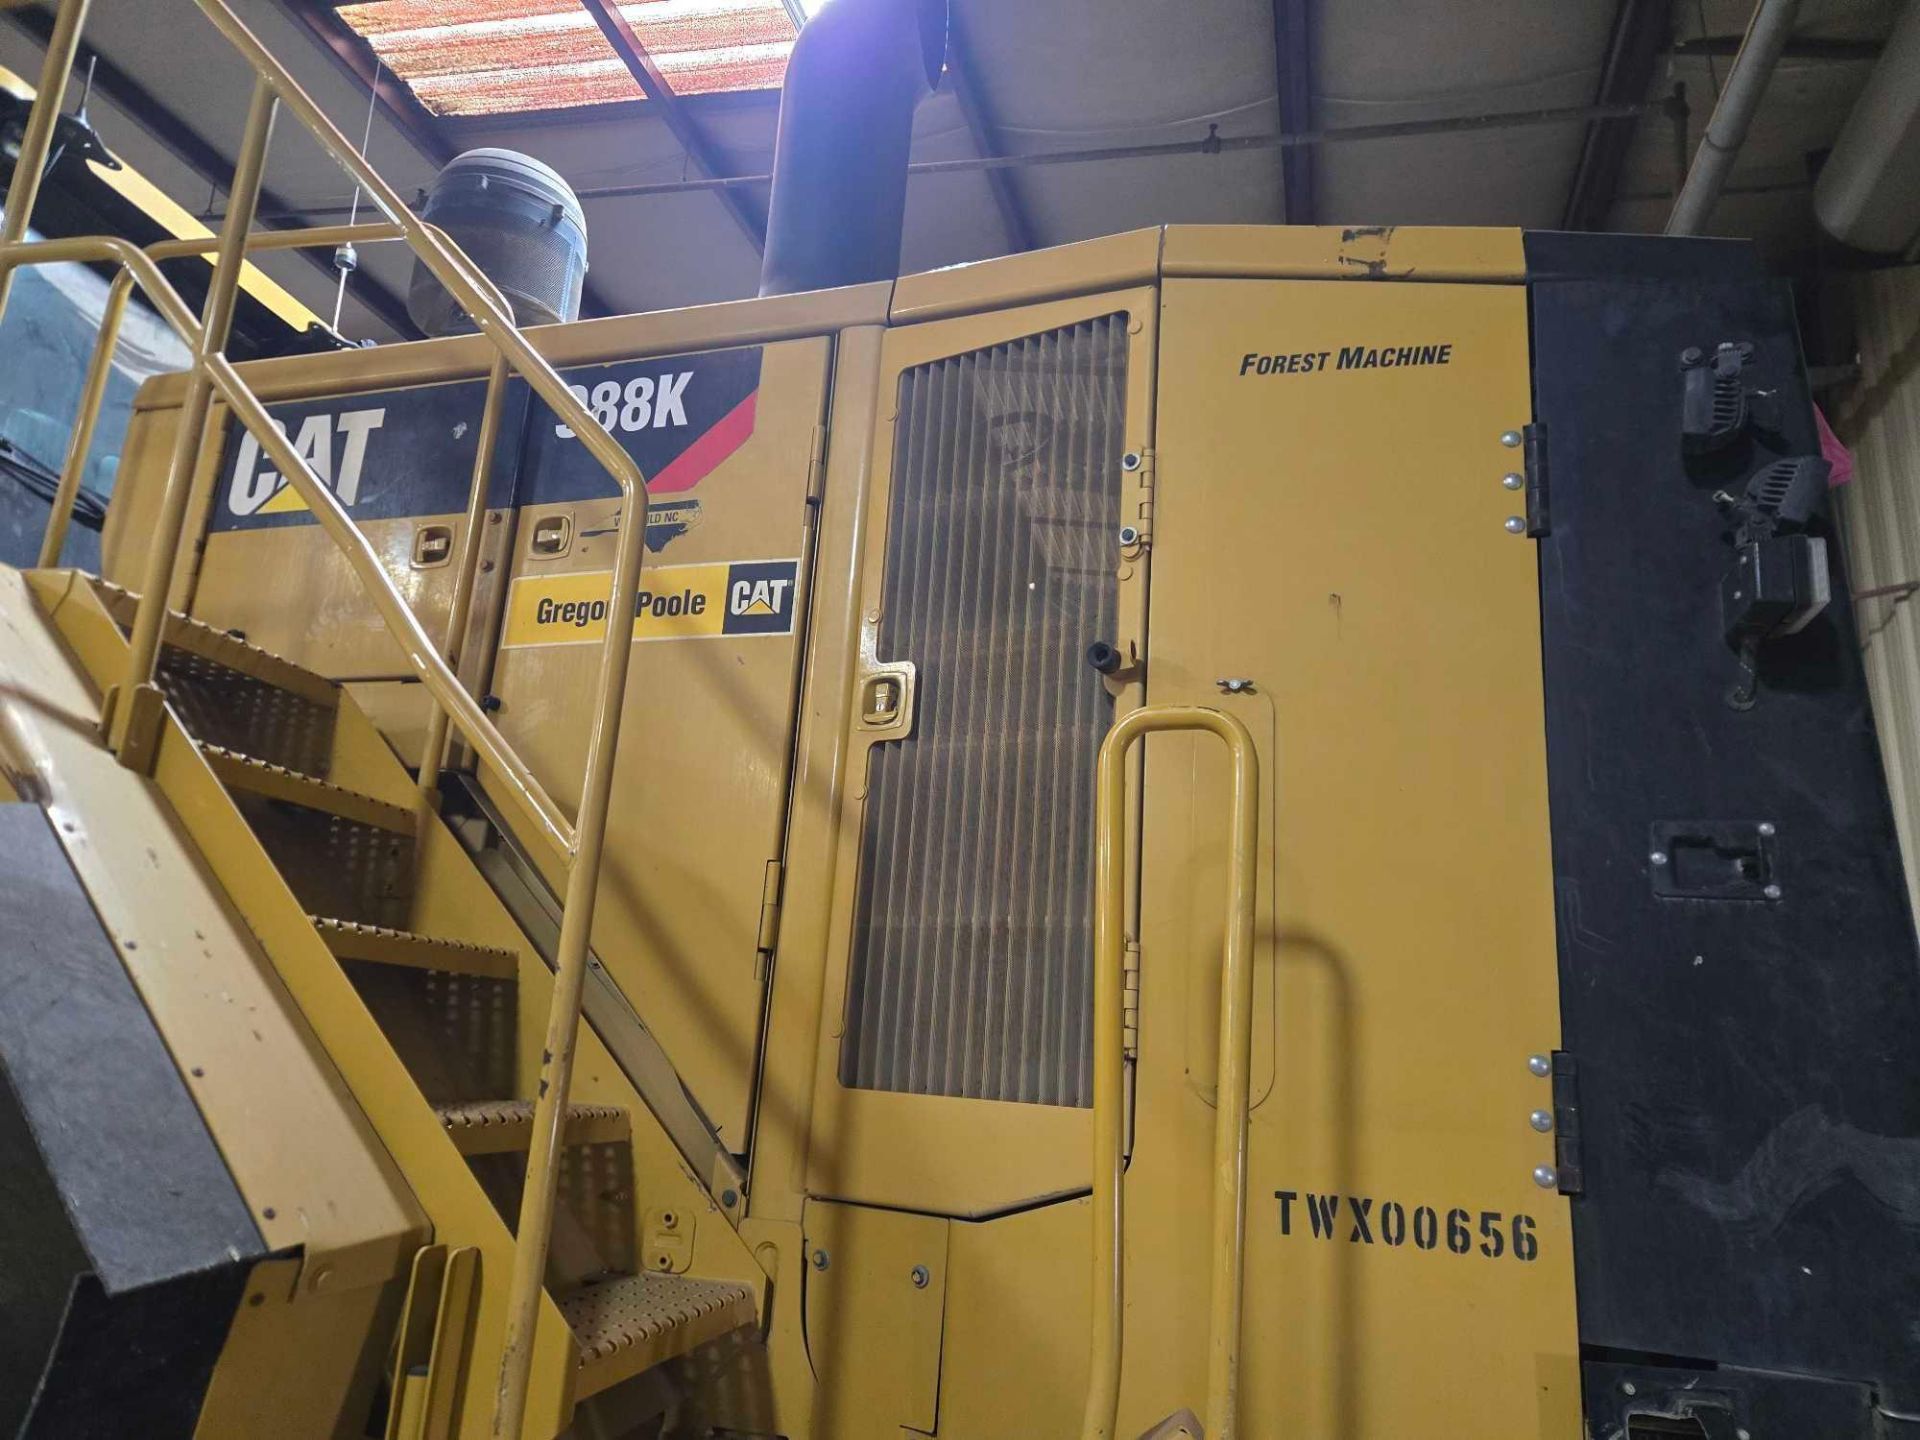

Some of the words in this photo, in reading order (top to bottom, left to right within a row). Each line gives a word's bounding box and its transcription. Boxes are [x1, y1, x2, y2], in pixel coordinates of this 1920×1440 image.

[1239, 352, 1330, 376] FOREST
[1336, 344, 1452, 370] MACHINE
[228, 408, 386, 516] CAT
[664, 511, 679, 523] NC
[536, 597, 608, 628] Grego
[636, 589, 706, 618] Poole
[1274, 1191, 1538, 1262] TWX00656
